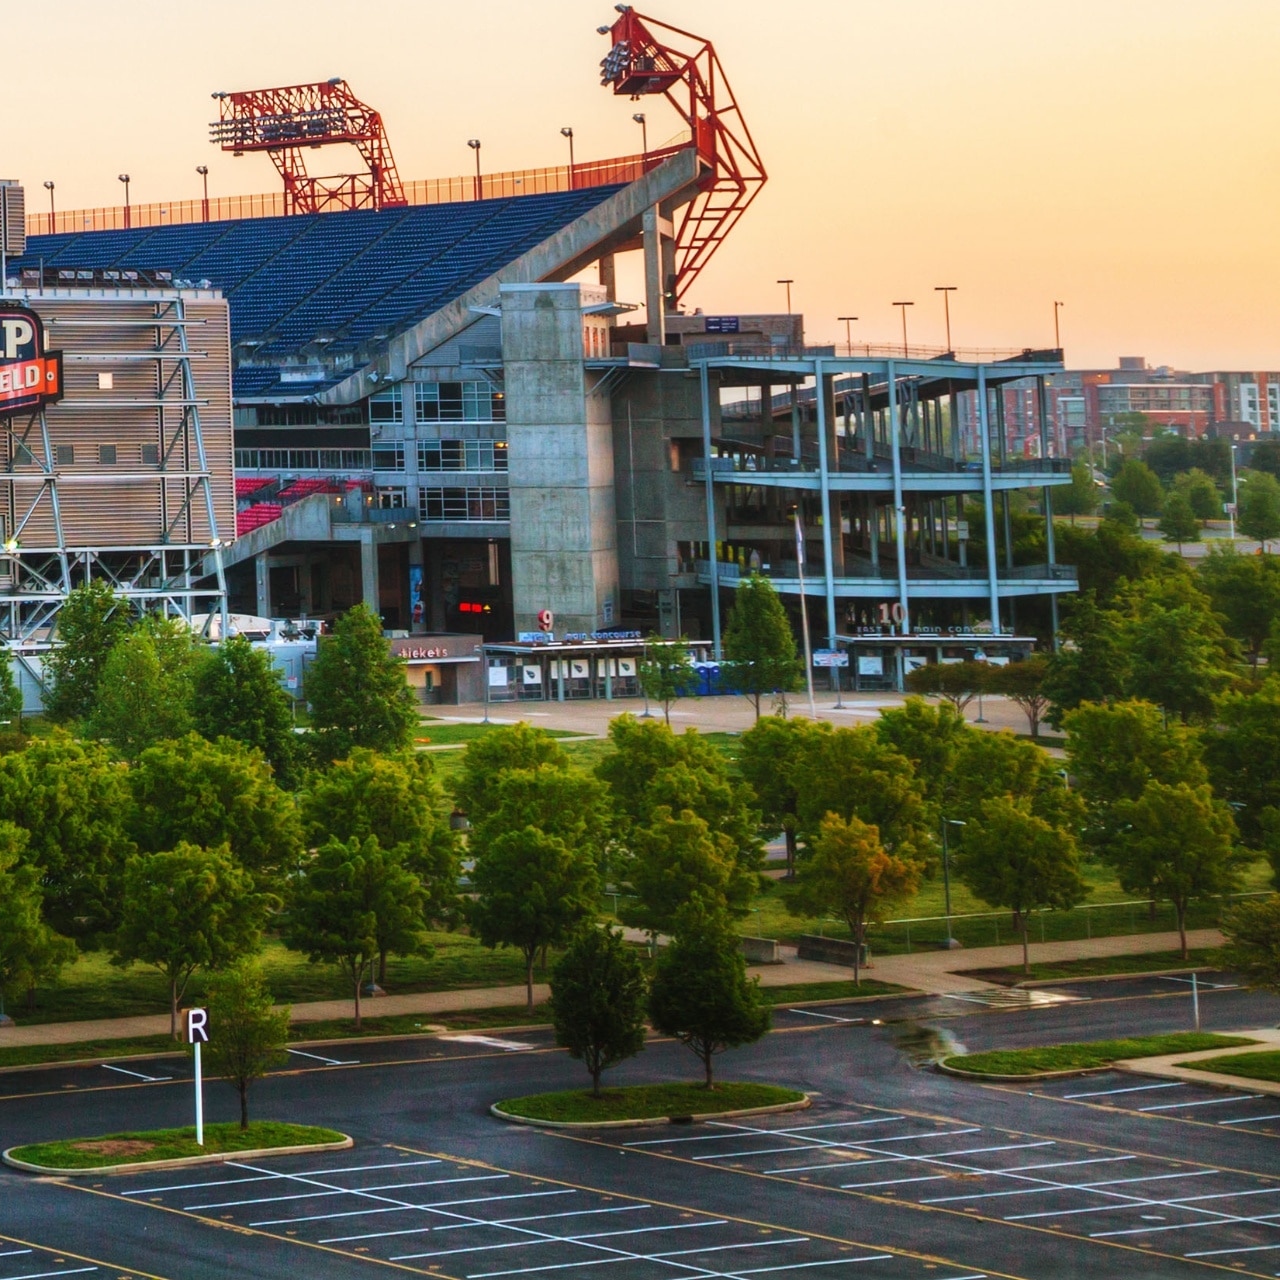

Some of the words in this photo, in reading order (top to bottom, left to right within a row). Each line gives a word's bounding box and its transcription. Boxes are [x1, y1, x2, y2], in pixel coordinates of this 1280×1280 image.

[538, 609, 554, 632] 9
[877, 603, 905, 624] 10
[948, 625, 1016, 633] concouse
[399, 647, 448, 659] tickets
[188, 1008, 209, 1044] R
